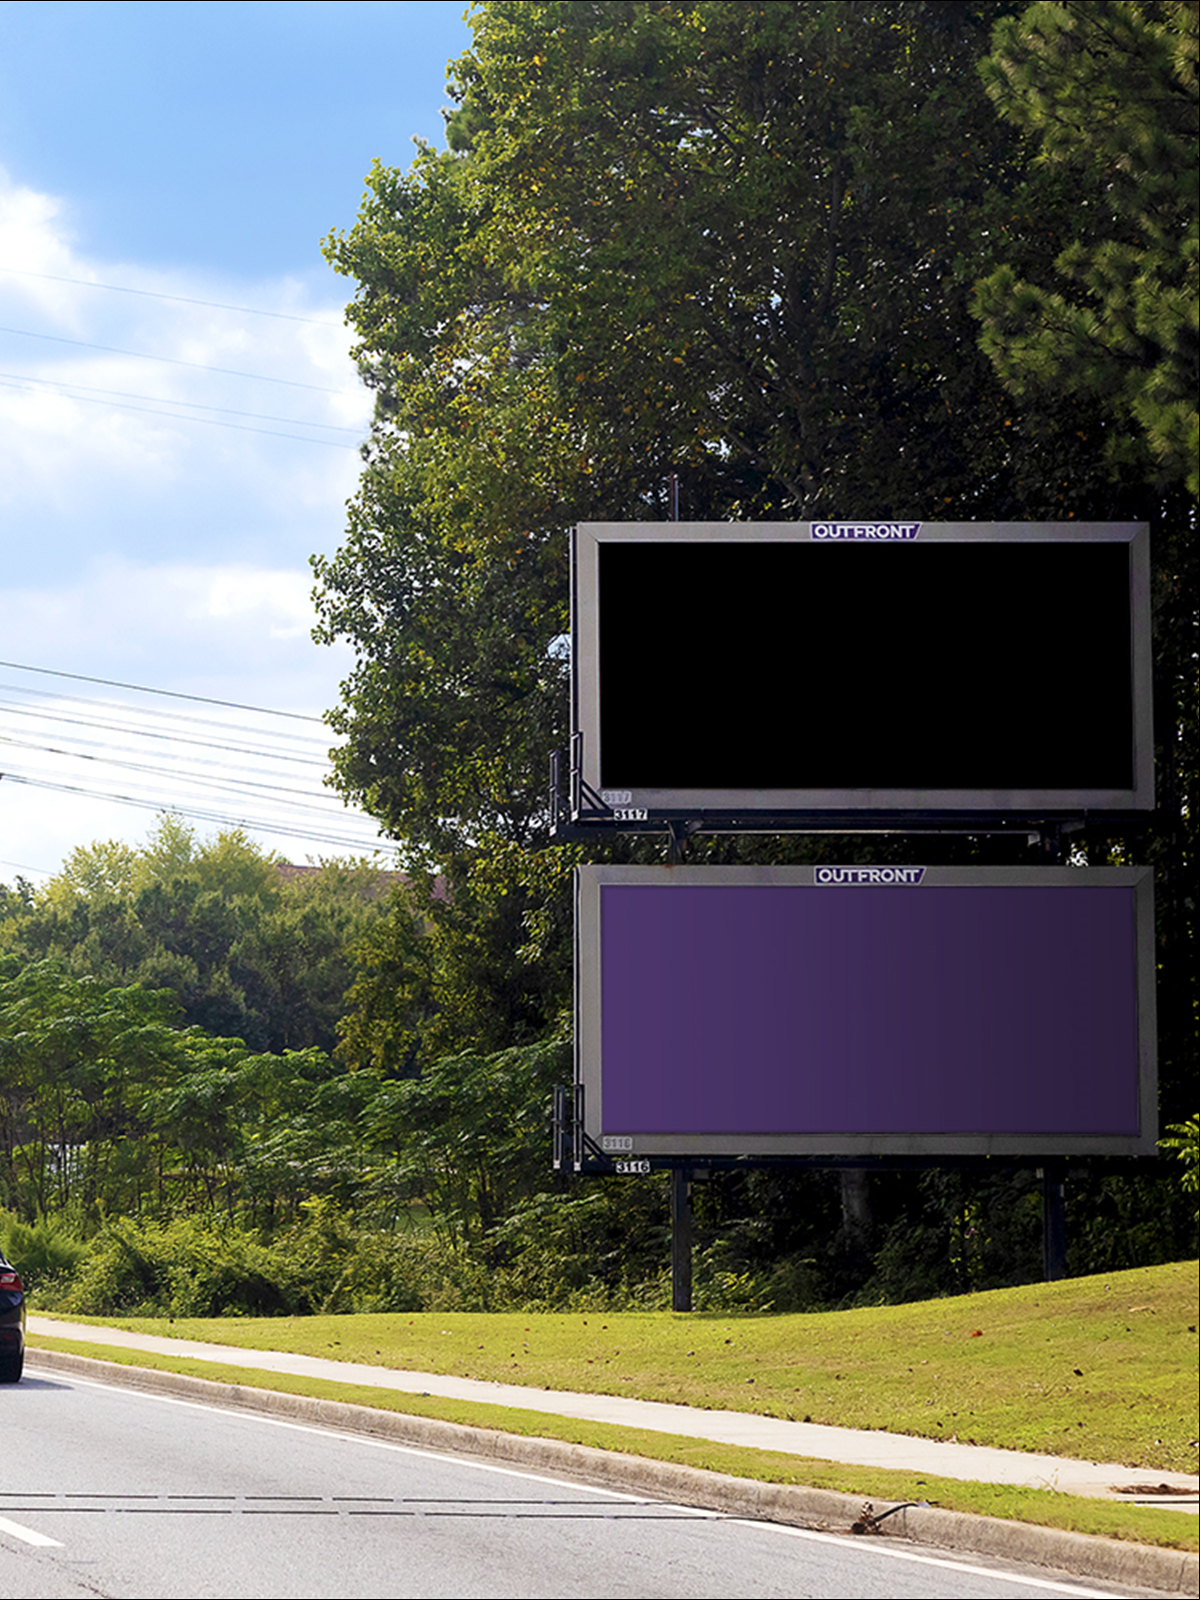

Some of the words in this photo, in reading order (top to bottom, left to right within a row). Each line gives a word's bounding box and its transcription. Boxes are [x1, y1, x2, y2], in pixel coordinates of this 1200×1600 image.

[814, 524, 916, 539] OUTFRONT
[614, 809, 647, 820] 3117
[818, 868, 920, 883] OUTFRONT
[604, 1137, 631, 1149] 3116
[616, 1161, 649, 1173] 3116
